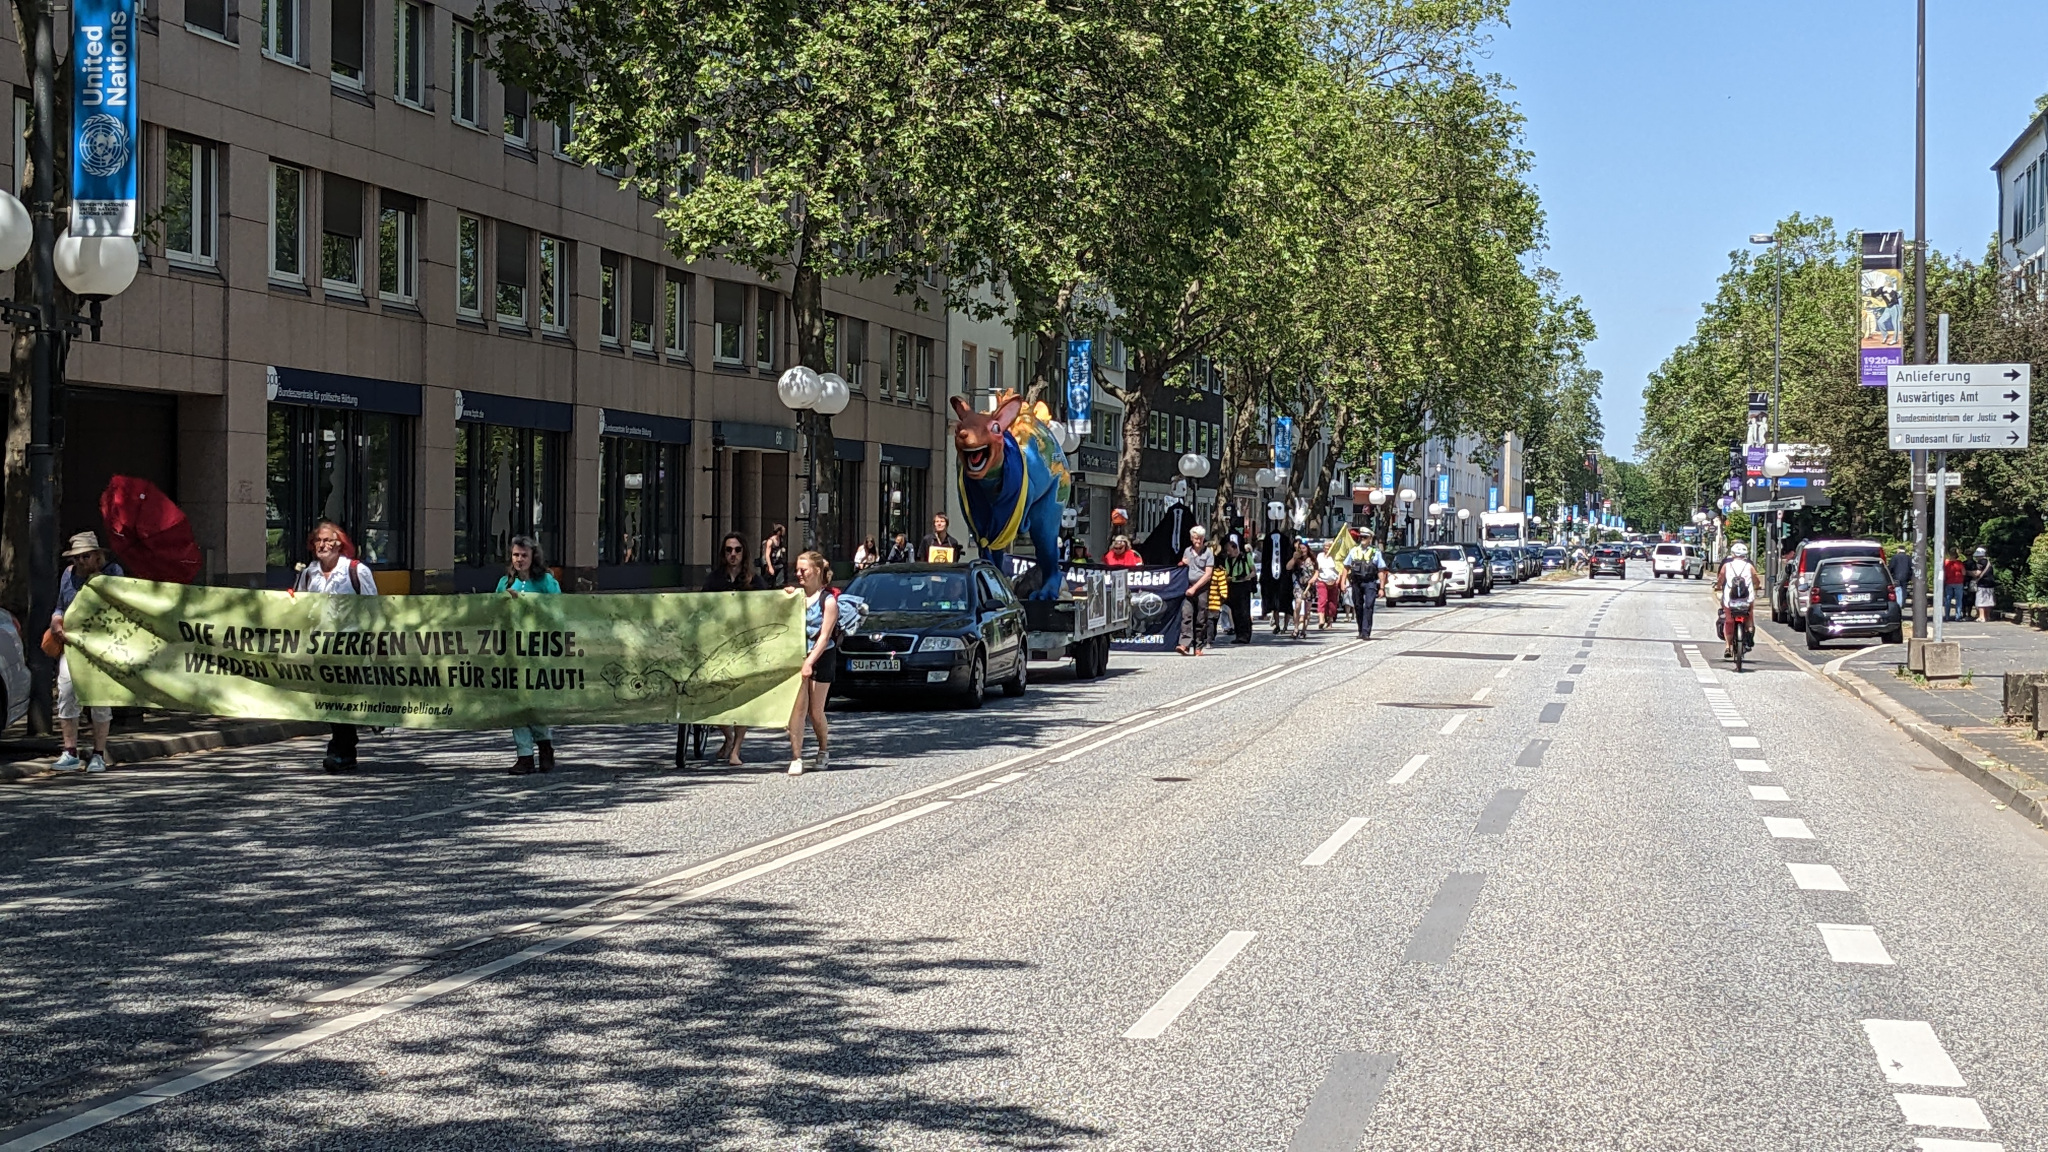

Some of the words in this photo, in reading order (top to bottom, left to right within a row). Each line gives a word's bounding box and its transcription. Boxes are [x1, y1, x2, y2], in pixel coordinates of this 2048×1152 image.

[81, 26, 103, 105] United
[106, 11, 127, 105] Nations
[1896, 370, 1971, 384] Anlieferung
[278, 387, 313, 400] Bundeszentrale
[320, 391, 341, 403] politische
[341, 393, 359, 407] Bildung
[1896, 391, 1955, 405] Auswärtiges
[1960, 391, 1979, 402] Amt
[1896, 413, 1960, 423] Bundesministerium
[1962, 412, 1974, 422] der
[1977, 412, 1997, 422] Justiz
[775, 430, 783, 446] 86
[1905, 433, 1948, 444] Bundesamt
[1952, 433, 1964, 443] für
[1967, 432, 1991, 443] Justiz
[178, 621, 215, 646] DIE
[222, 626, 300, 654] ARTEN
[306, 630, 406, 656] STERBEN
[415, 631, 469, 656] VIEL
[477, 630, 507, 656] ZU
[515, 630, 585, 657] LEISE.
[184, 652, 270, 679] WERDEN
[271, 661, 316, 682] WIR
[319, 664, 442, 687] GEMEINSAM
[447, 660, 485, 688] FÜR
[491, 667, 519, 690] SIE
[525, 668, 585, 690] LAUT!
[852, 660, 864, 670] SU
[314, 700, 454, 716] www.extinctionrebellion.de
